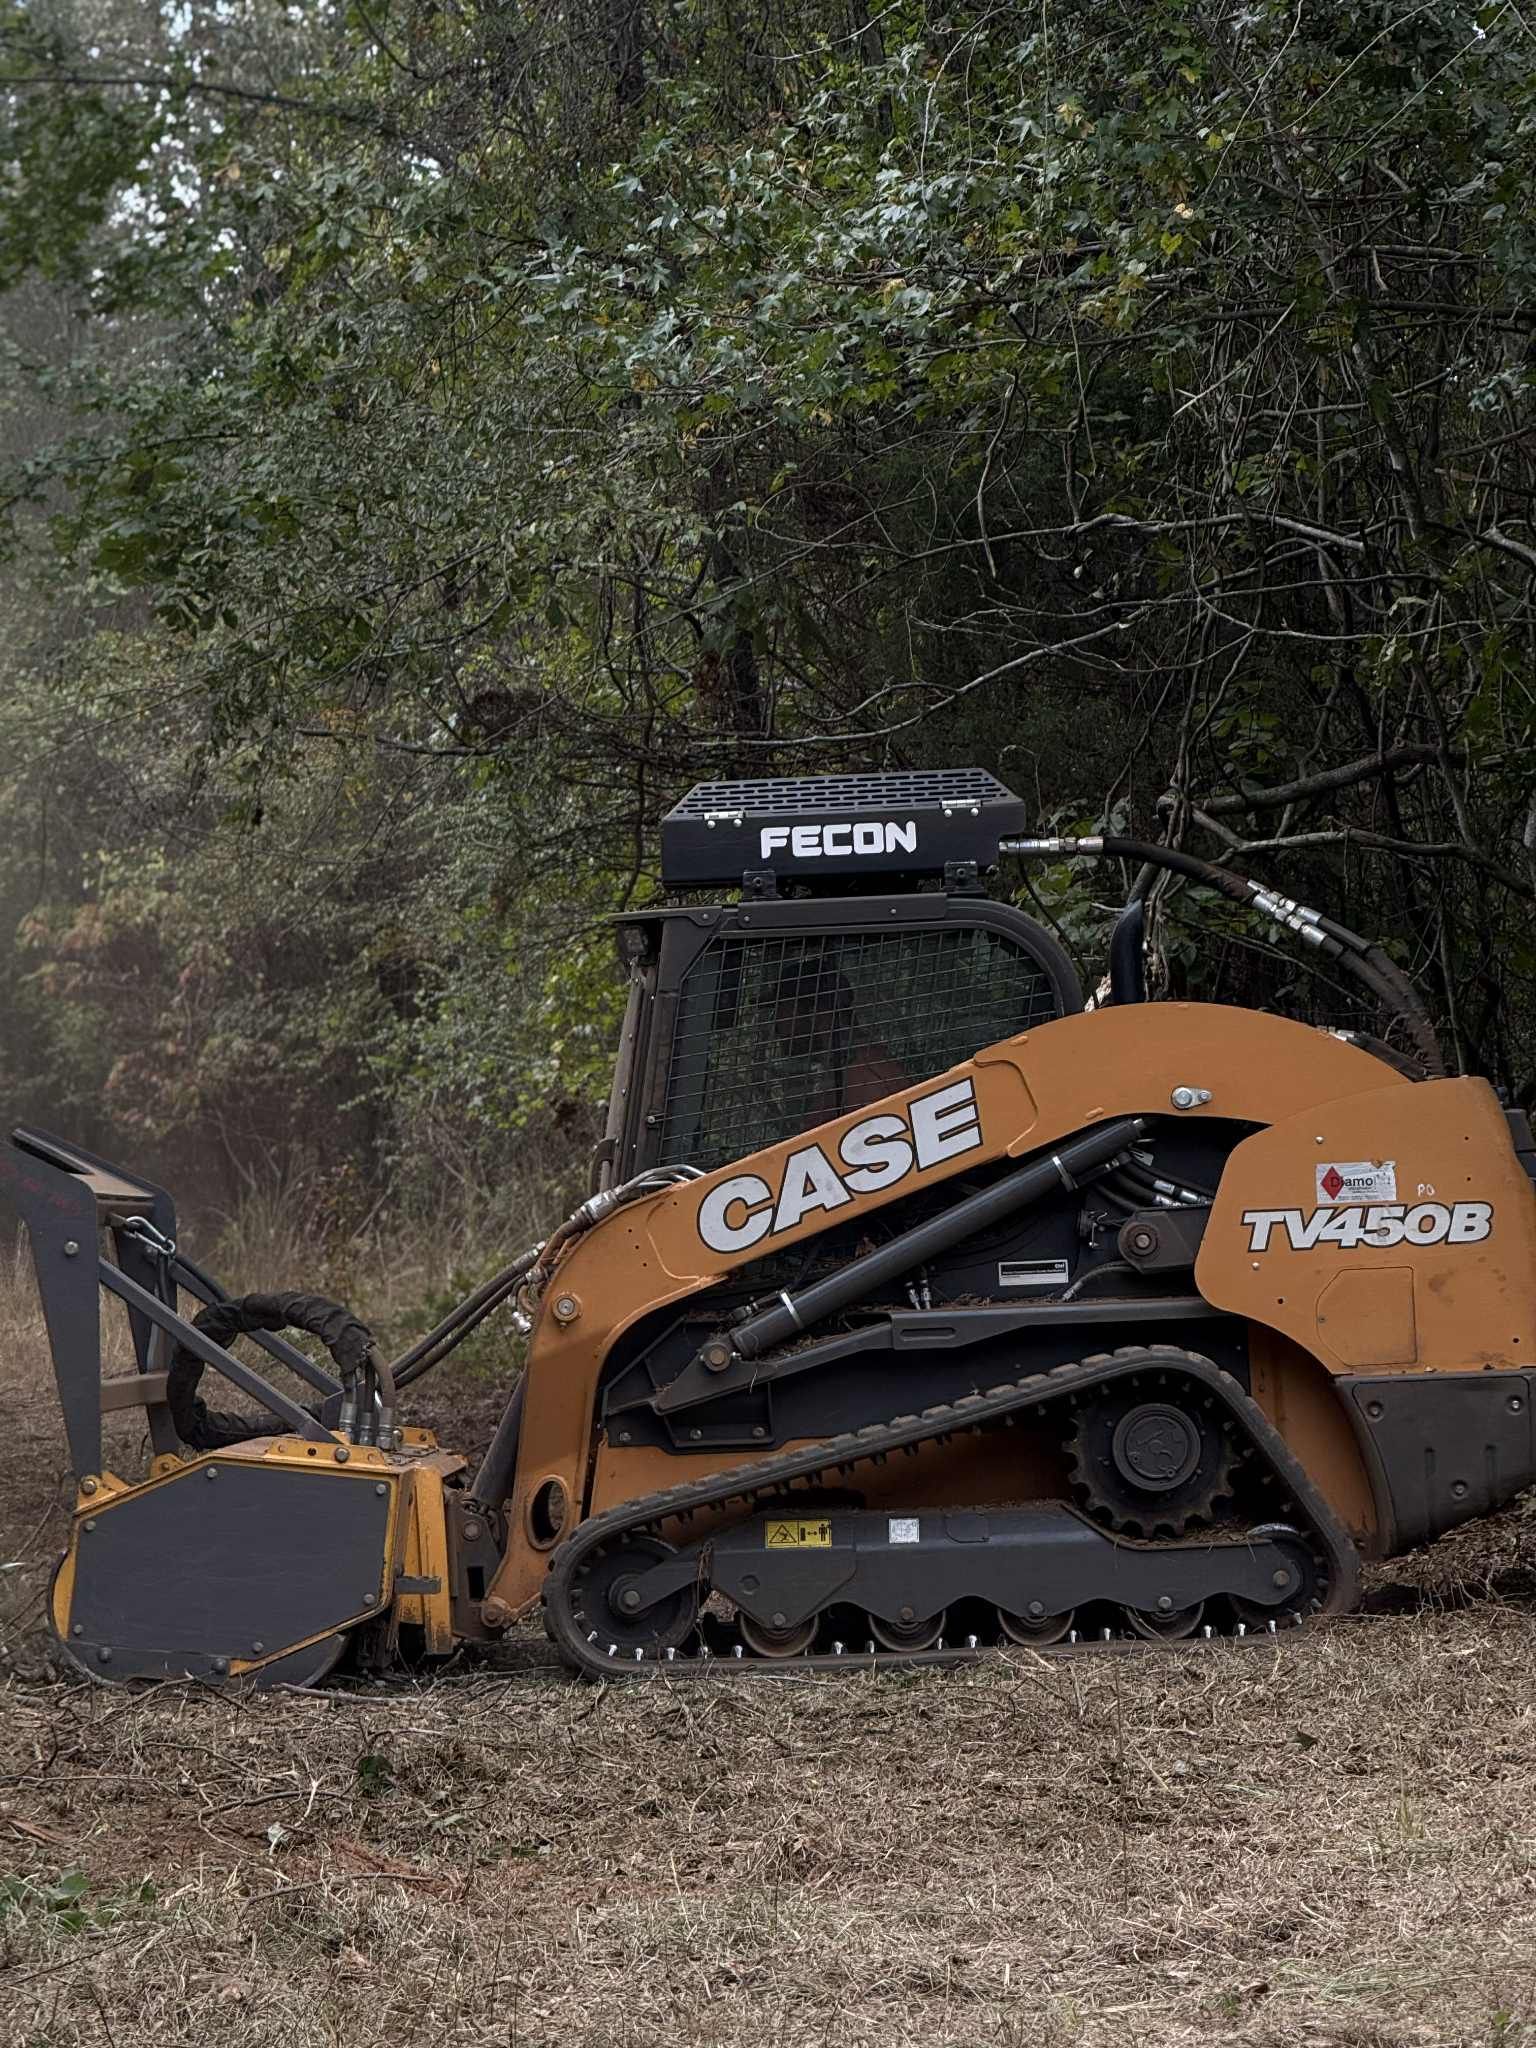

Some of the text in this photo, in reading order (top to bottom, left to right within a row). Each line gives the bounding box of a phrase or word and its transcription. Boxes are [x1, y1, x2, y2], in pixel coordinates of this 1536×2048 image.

[760, 820, 917, 859] FECON
[697, 1076, 983, 1254] CASE
[1330, 1174, 1382, 1187] Diamo
[1242, 1202, 1493, 1252] TV450B
